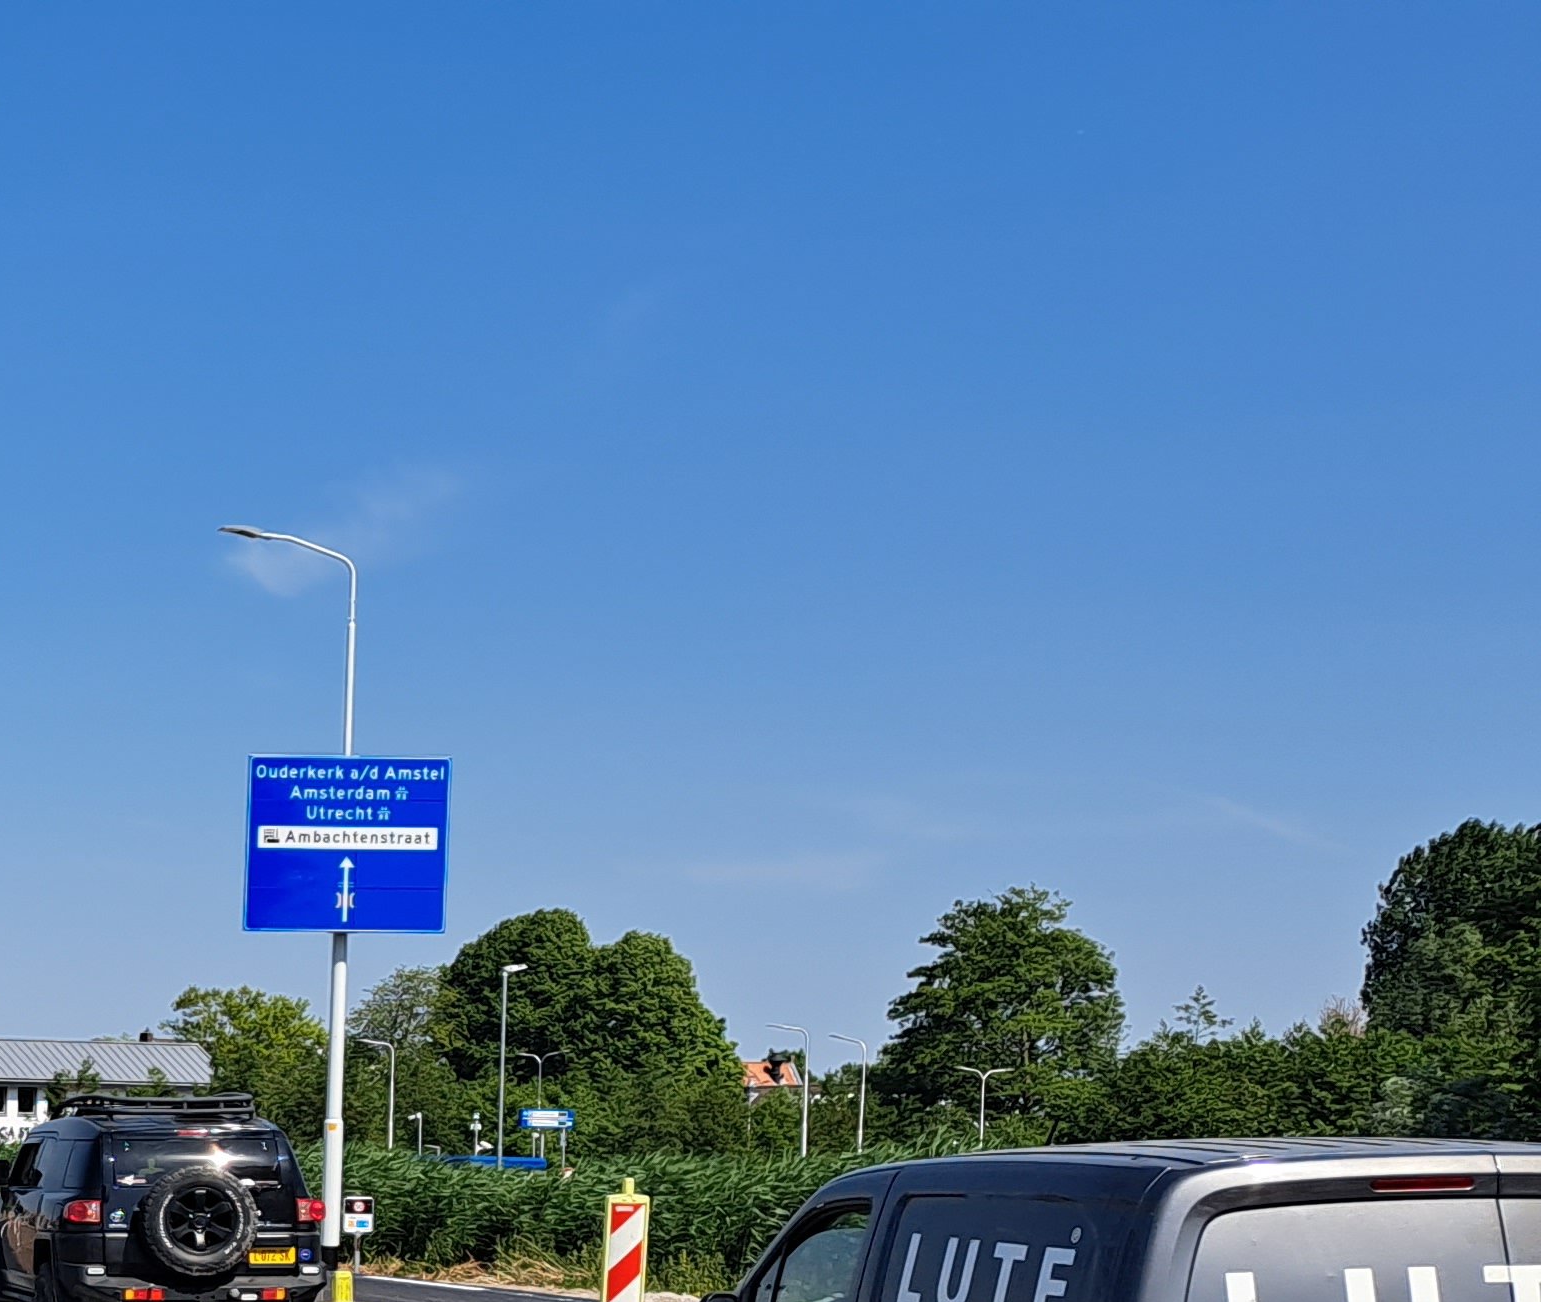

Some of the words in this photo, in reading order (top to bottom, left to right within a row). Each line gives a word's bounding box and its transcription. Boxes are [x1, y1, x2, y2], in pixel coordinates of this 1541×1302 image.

[256, 764, 344, 779] Ouderkerk
[350, 766, 379, 781] a/d
[384, 766, 445, 780] Amstel
[290, 785, 390, 800] Amsterdam
[306, 805, 373, 820] Utrecht
[285, 830, 431, 845] Ambachtenstraat
